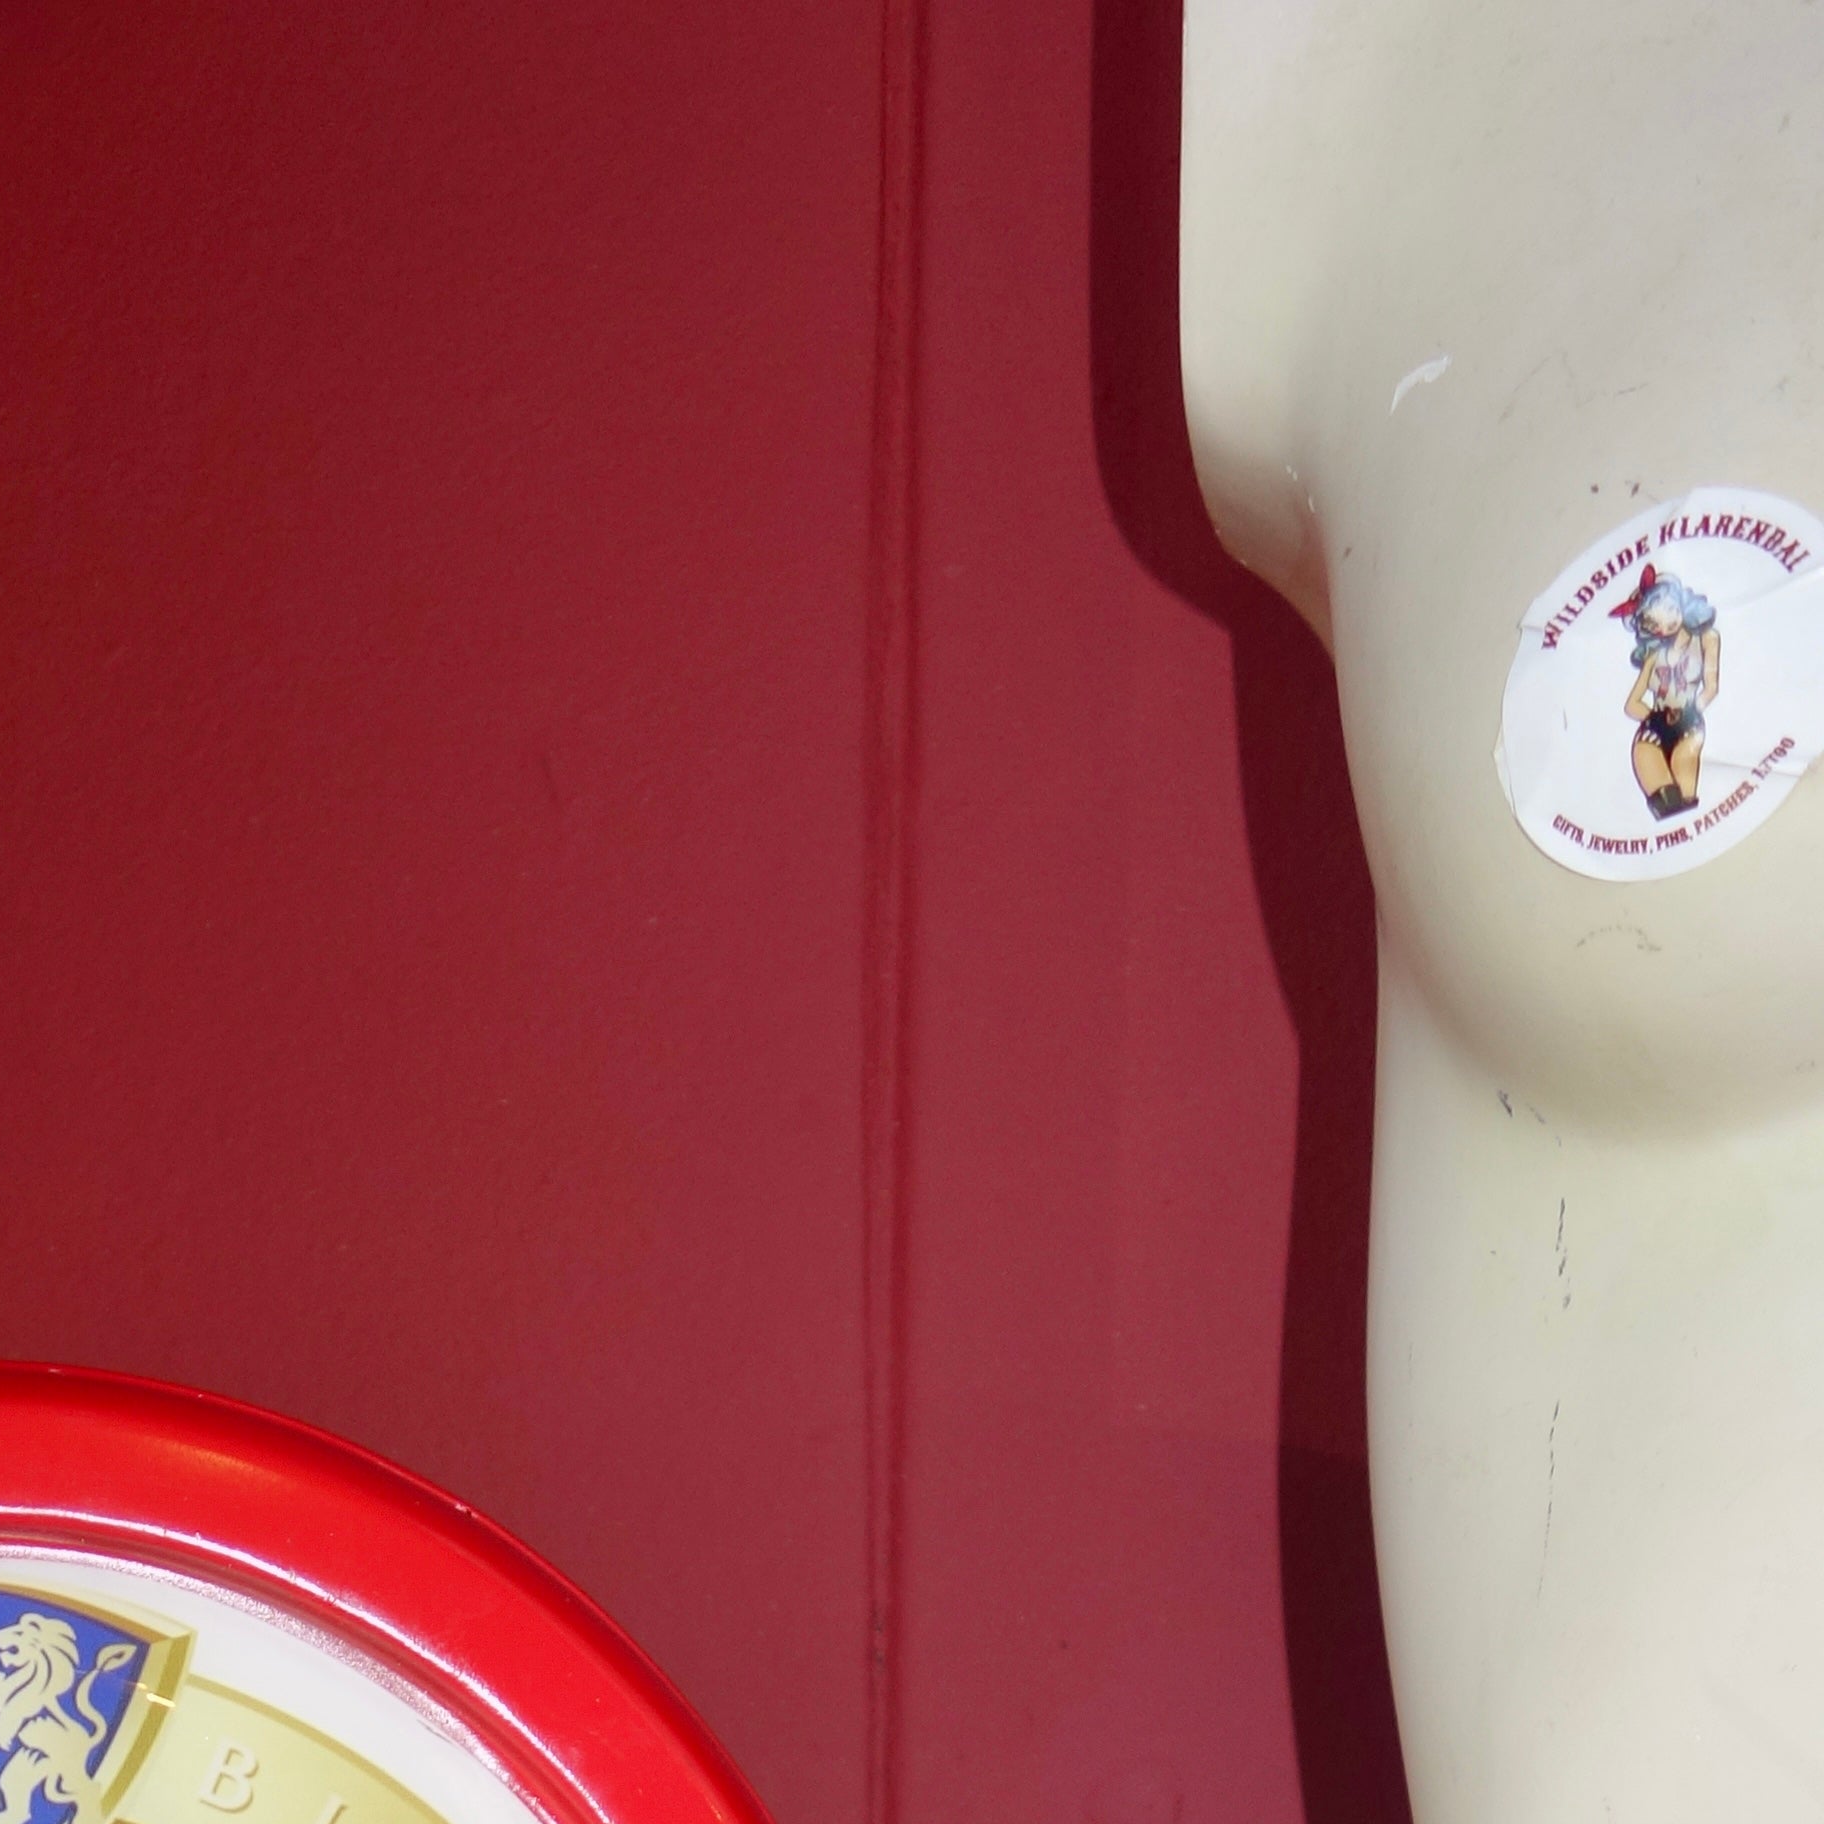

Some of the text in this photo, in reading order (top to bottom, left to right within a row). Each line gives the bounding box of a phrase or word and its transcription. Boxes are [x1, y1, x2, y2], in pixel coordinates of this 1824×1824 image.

[1541, 535, 1651, 651] WILDSIDE
[1693, 780, 1759, 836] PATCHES,
[1750, 736, 1796, 780] TTTOO
